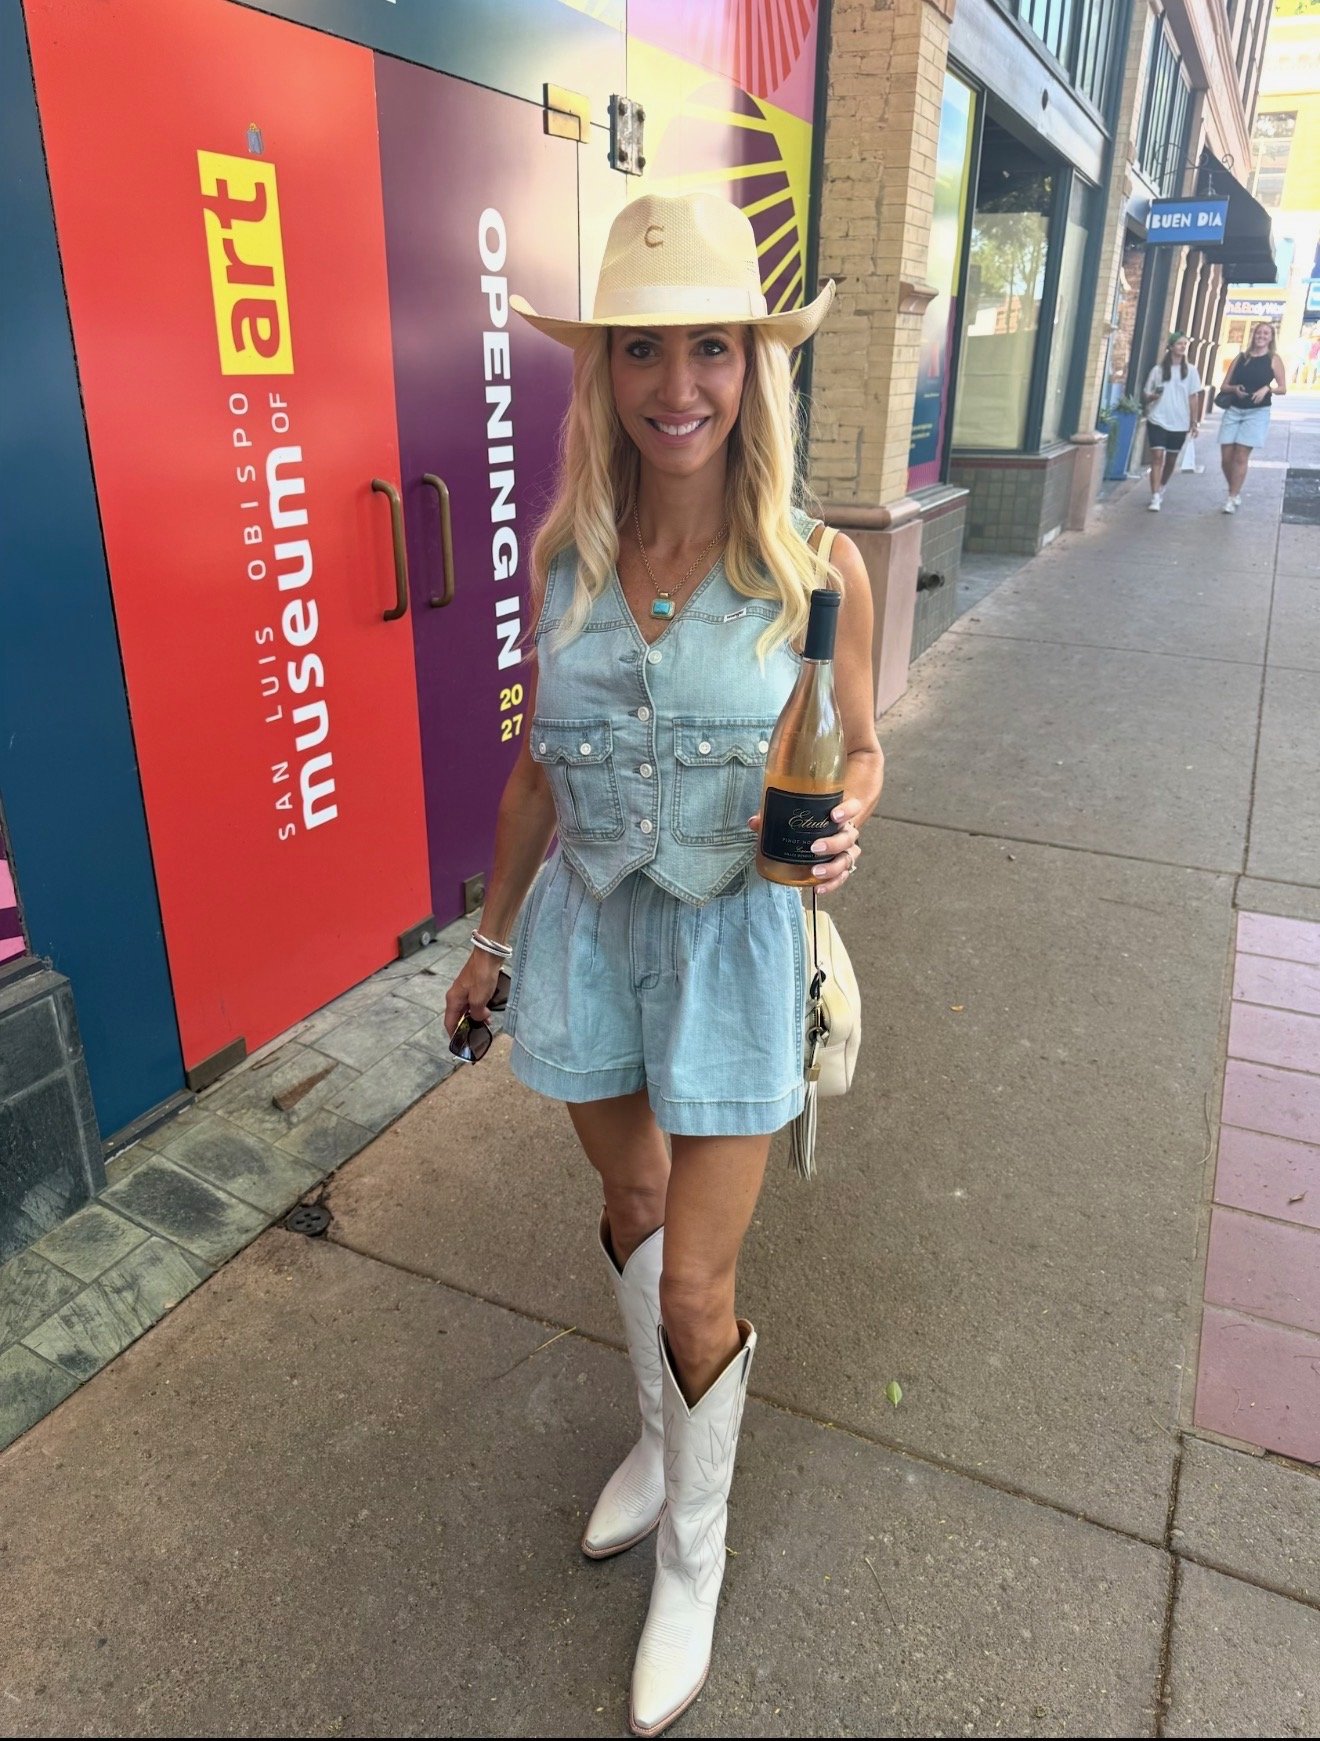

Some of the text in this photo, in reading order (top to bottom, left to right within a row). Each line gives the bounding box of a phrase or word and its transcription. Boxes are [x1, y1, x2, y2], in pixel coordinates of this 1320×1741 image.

[1151, 213, 1192, 229] BUEN
[201, 178, 338, 830] museum OF art
[477, 207, 521, 670] OPENING IN
[229, 393, 296, 841] SAN LUIS OBISPO
[500, 684, 523, 711] 20
[502, 714, 523, 742] 27
